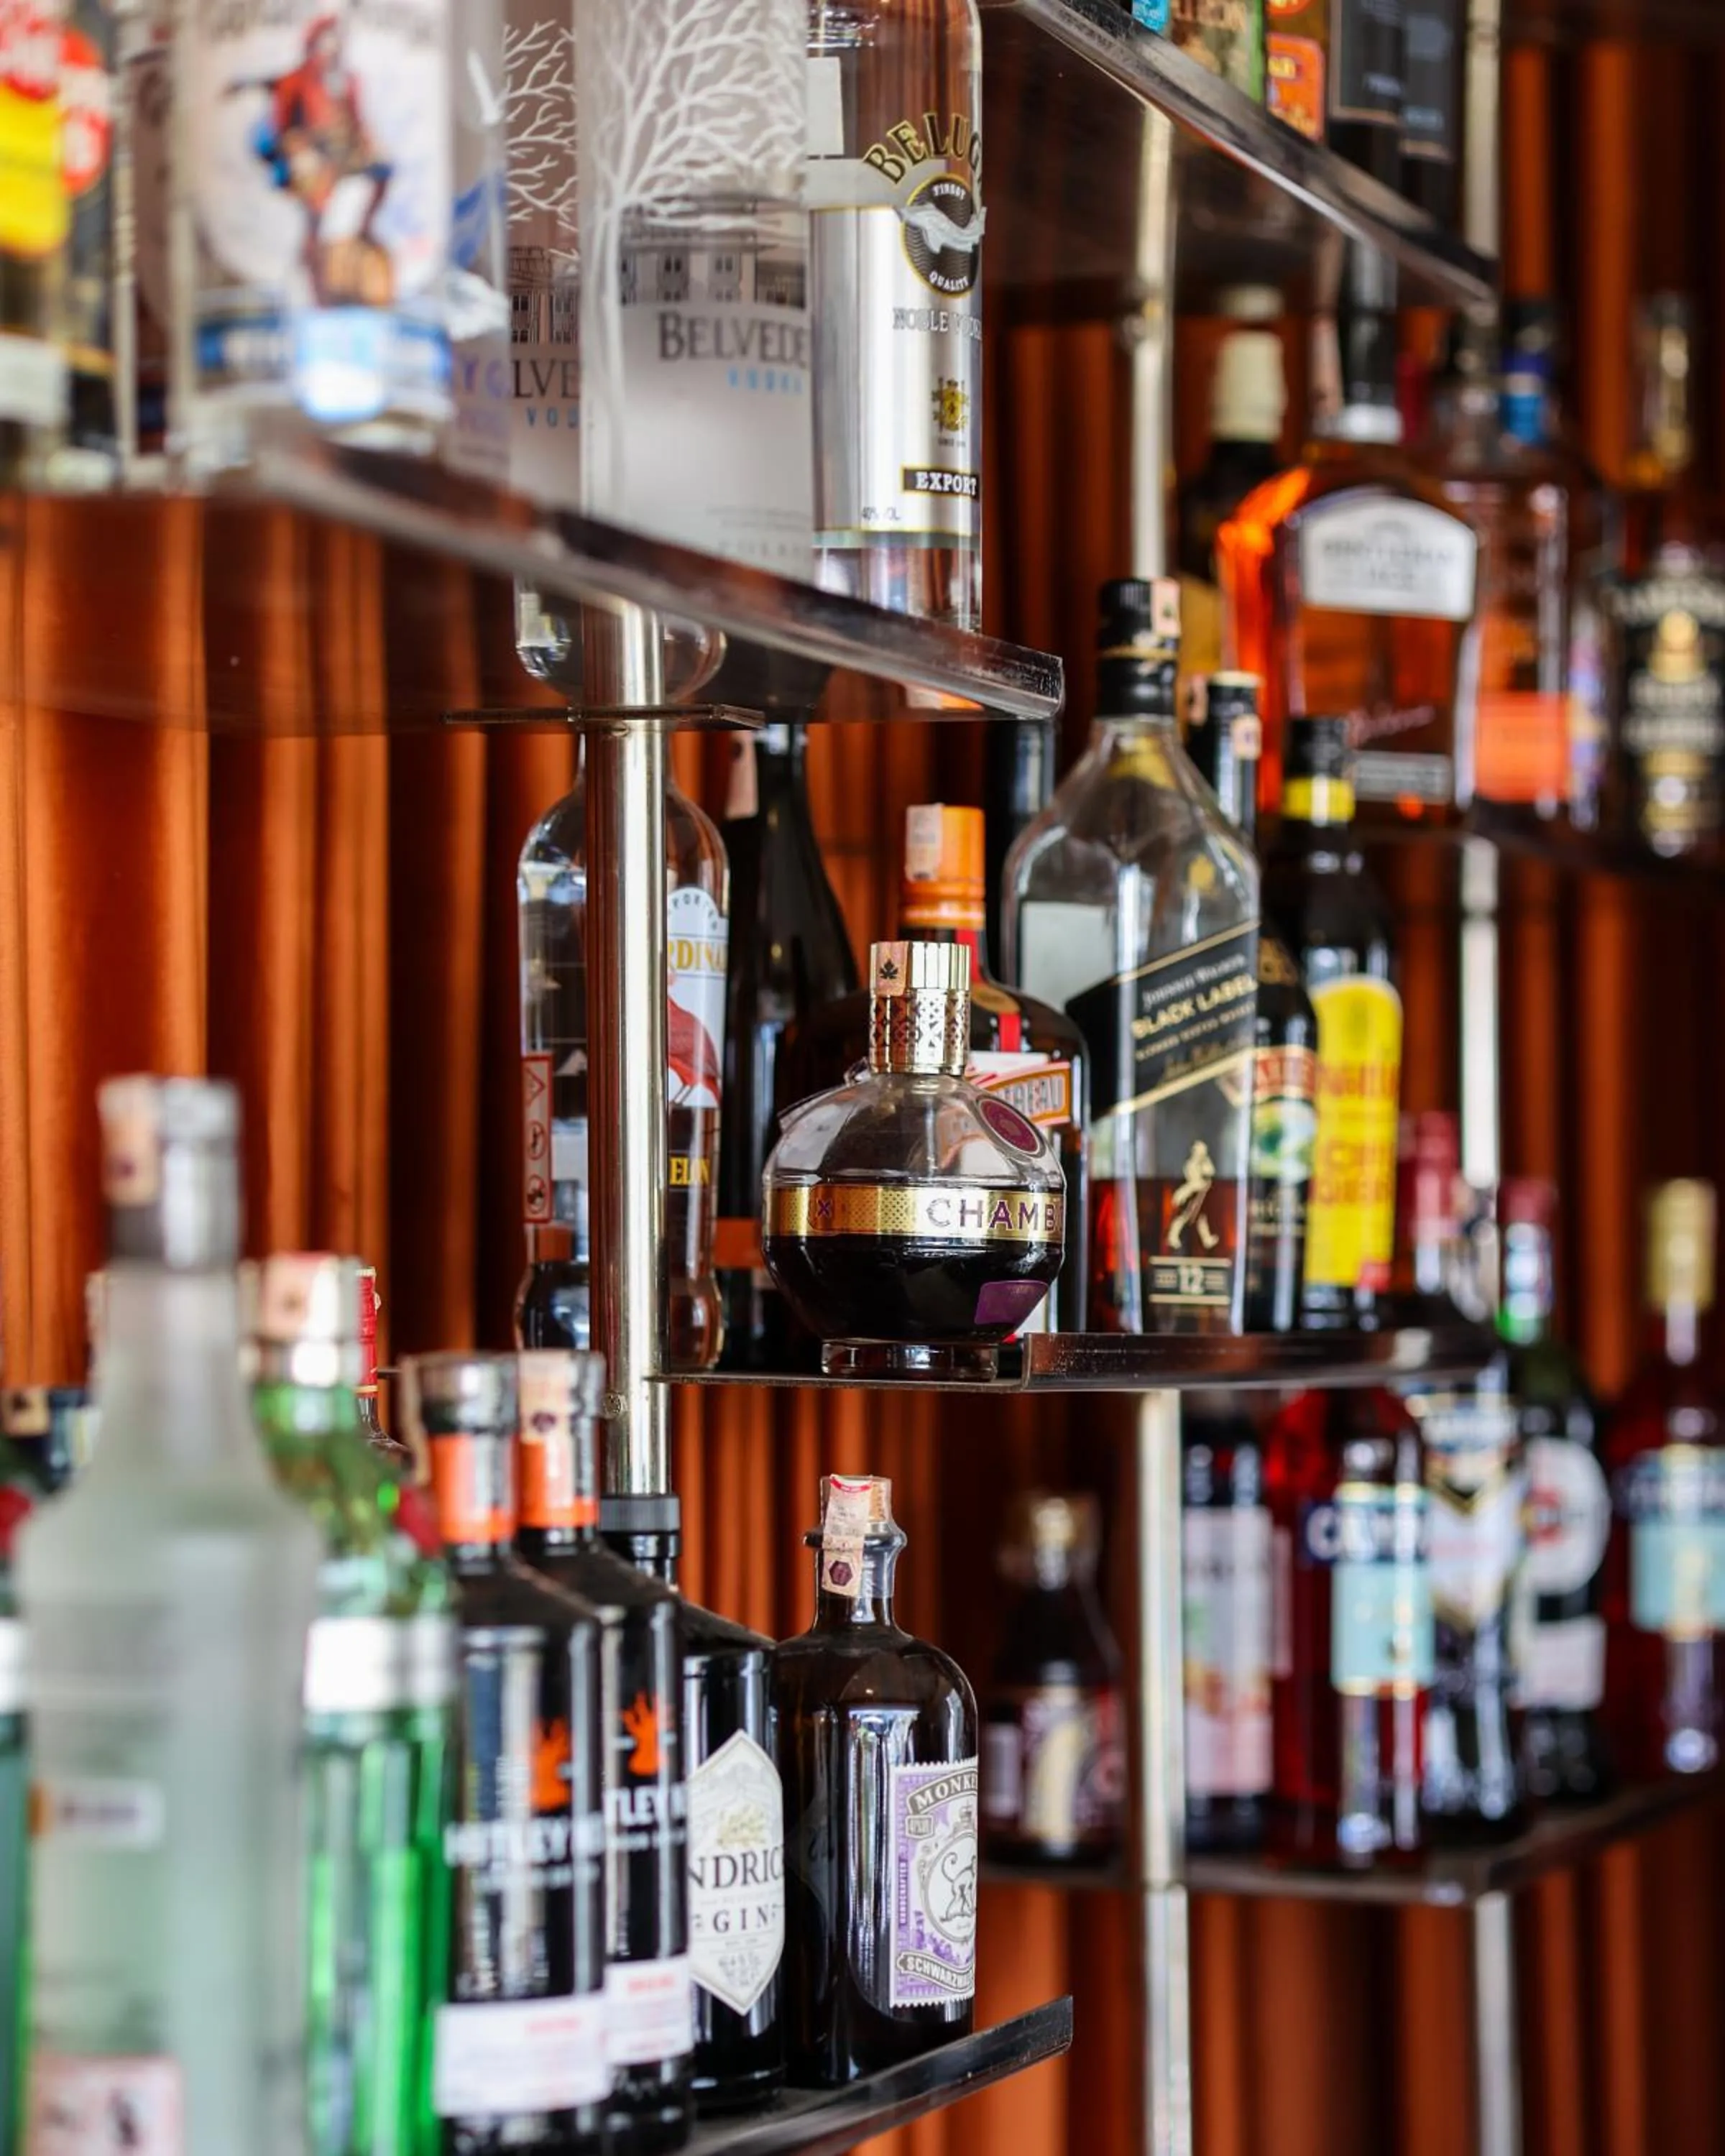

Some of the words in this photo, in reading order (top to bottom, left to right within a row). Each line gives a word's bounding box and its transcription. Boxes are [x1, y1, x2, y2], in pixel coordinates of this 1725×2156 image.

[862, 112, 980, 189] BELUG
[929, 270, 968, 291] QUALITY
[916, 471, 976, 496] EXPORT
[1131, 999, 1196, 1039] BLACK
[1195, 974, 1258, 1012] LABEL
[926, 1197, 1055, 1232] CHAMB
[1179, 1266, 1205, 1294] 12
[713, 1906, 769, 1934] GIN
